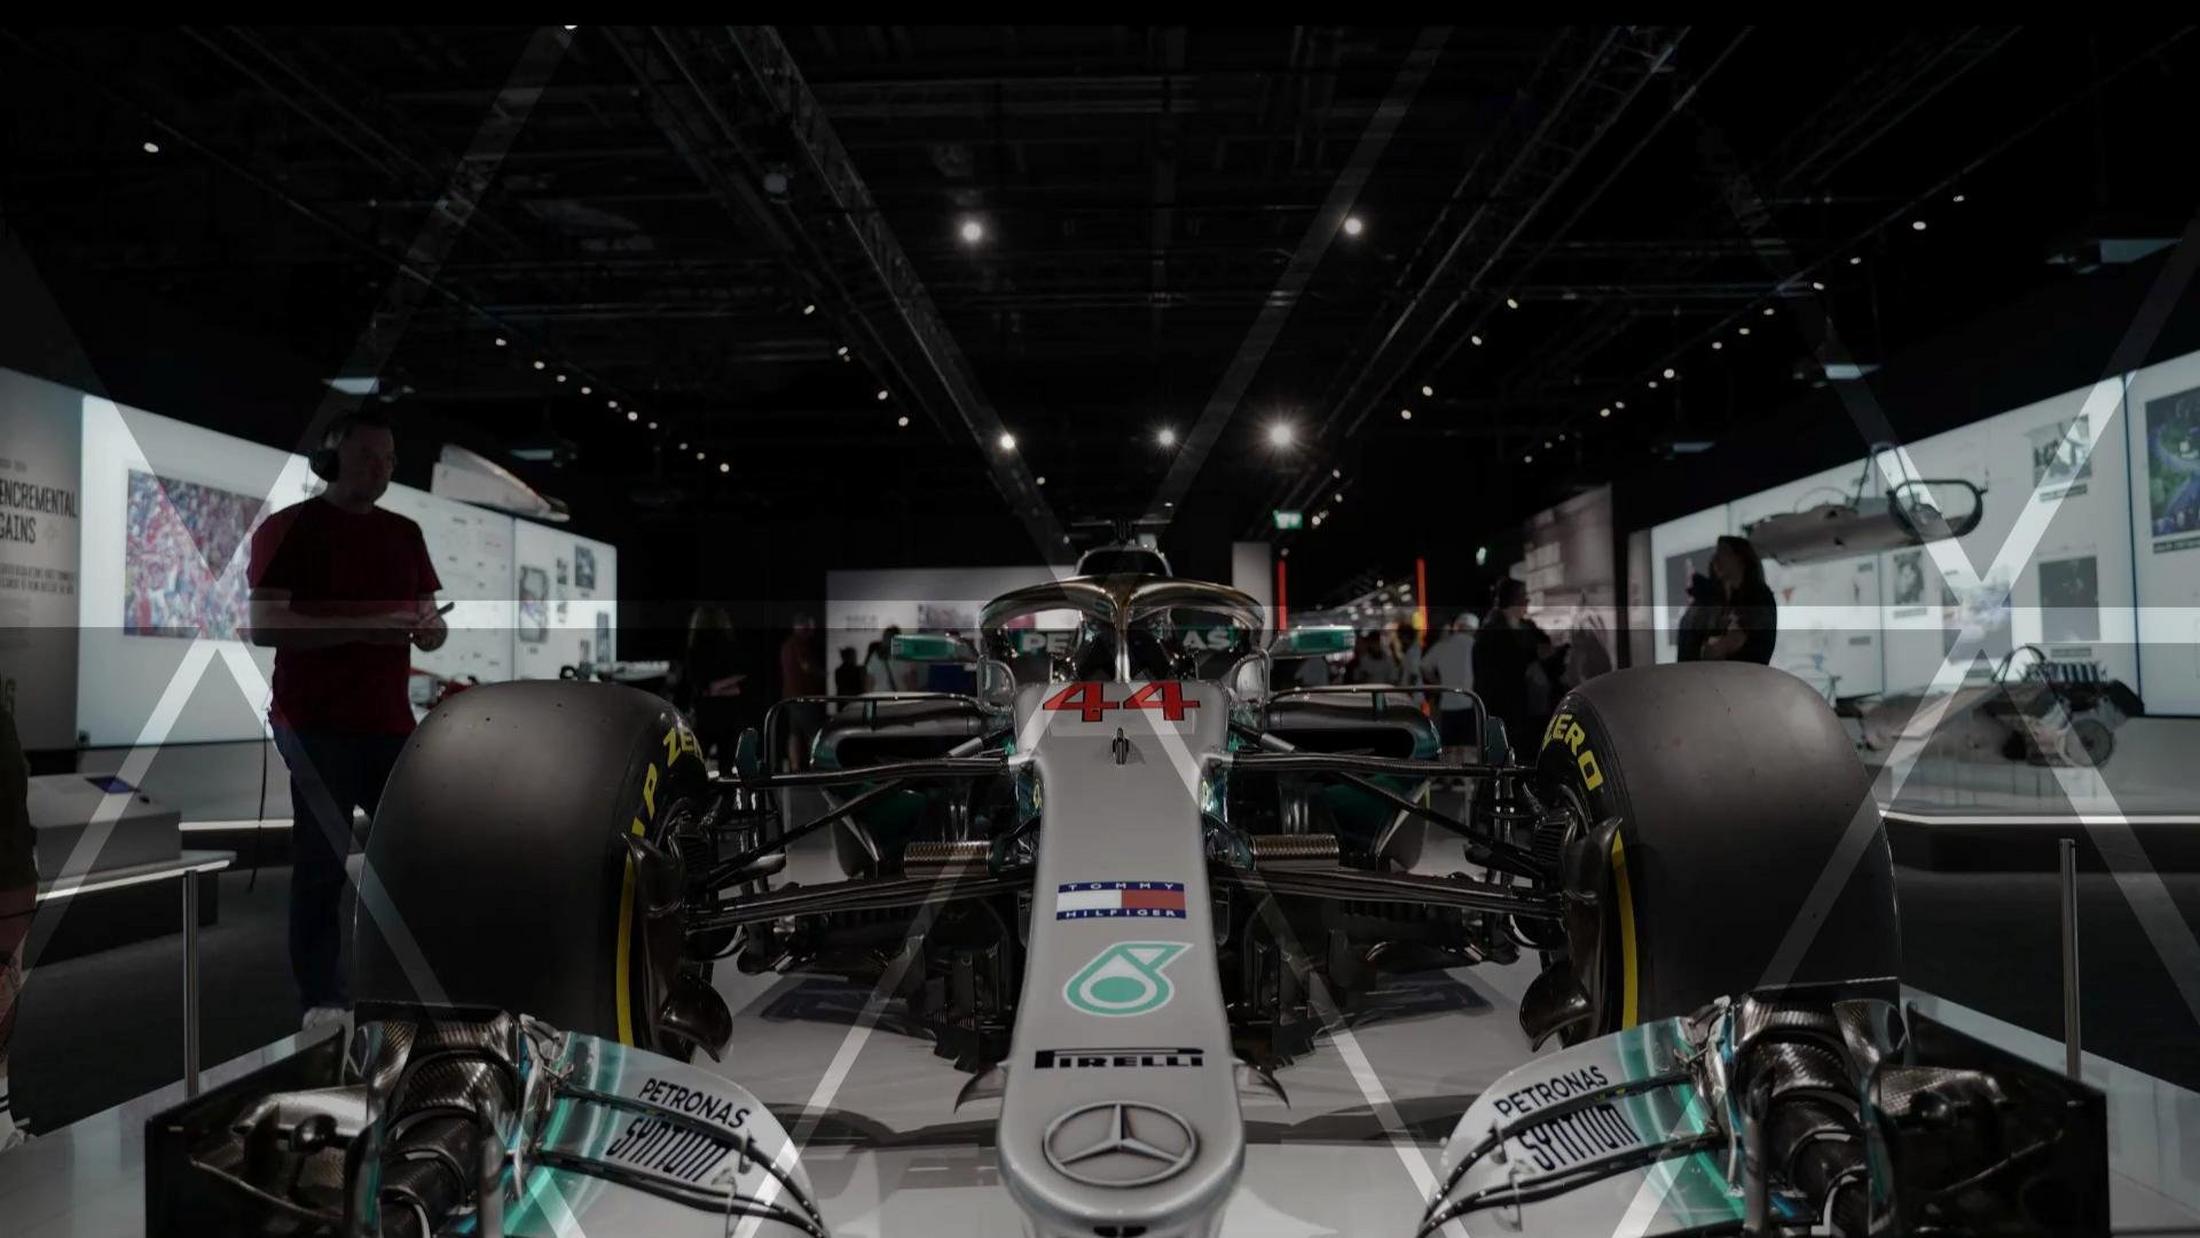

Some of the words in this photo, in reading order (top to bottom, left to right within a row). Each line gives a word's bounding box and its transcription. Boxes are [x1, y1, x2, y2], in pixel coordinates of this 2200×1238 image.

[1042, 680, 1200, 722] 44
[1068, 882, 1175, 891] TOMMY
[1066, 908, 1177, 918] HILFIGER
[1034, 1047, 1204, 1069] PIRELLI
[638, 1077, 750, 1129] PETRONAS
[1493, 1065, 1609, 1118] PETRONAS
